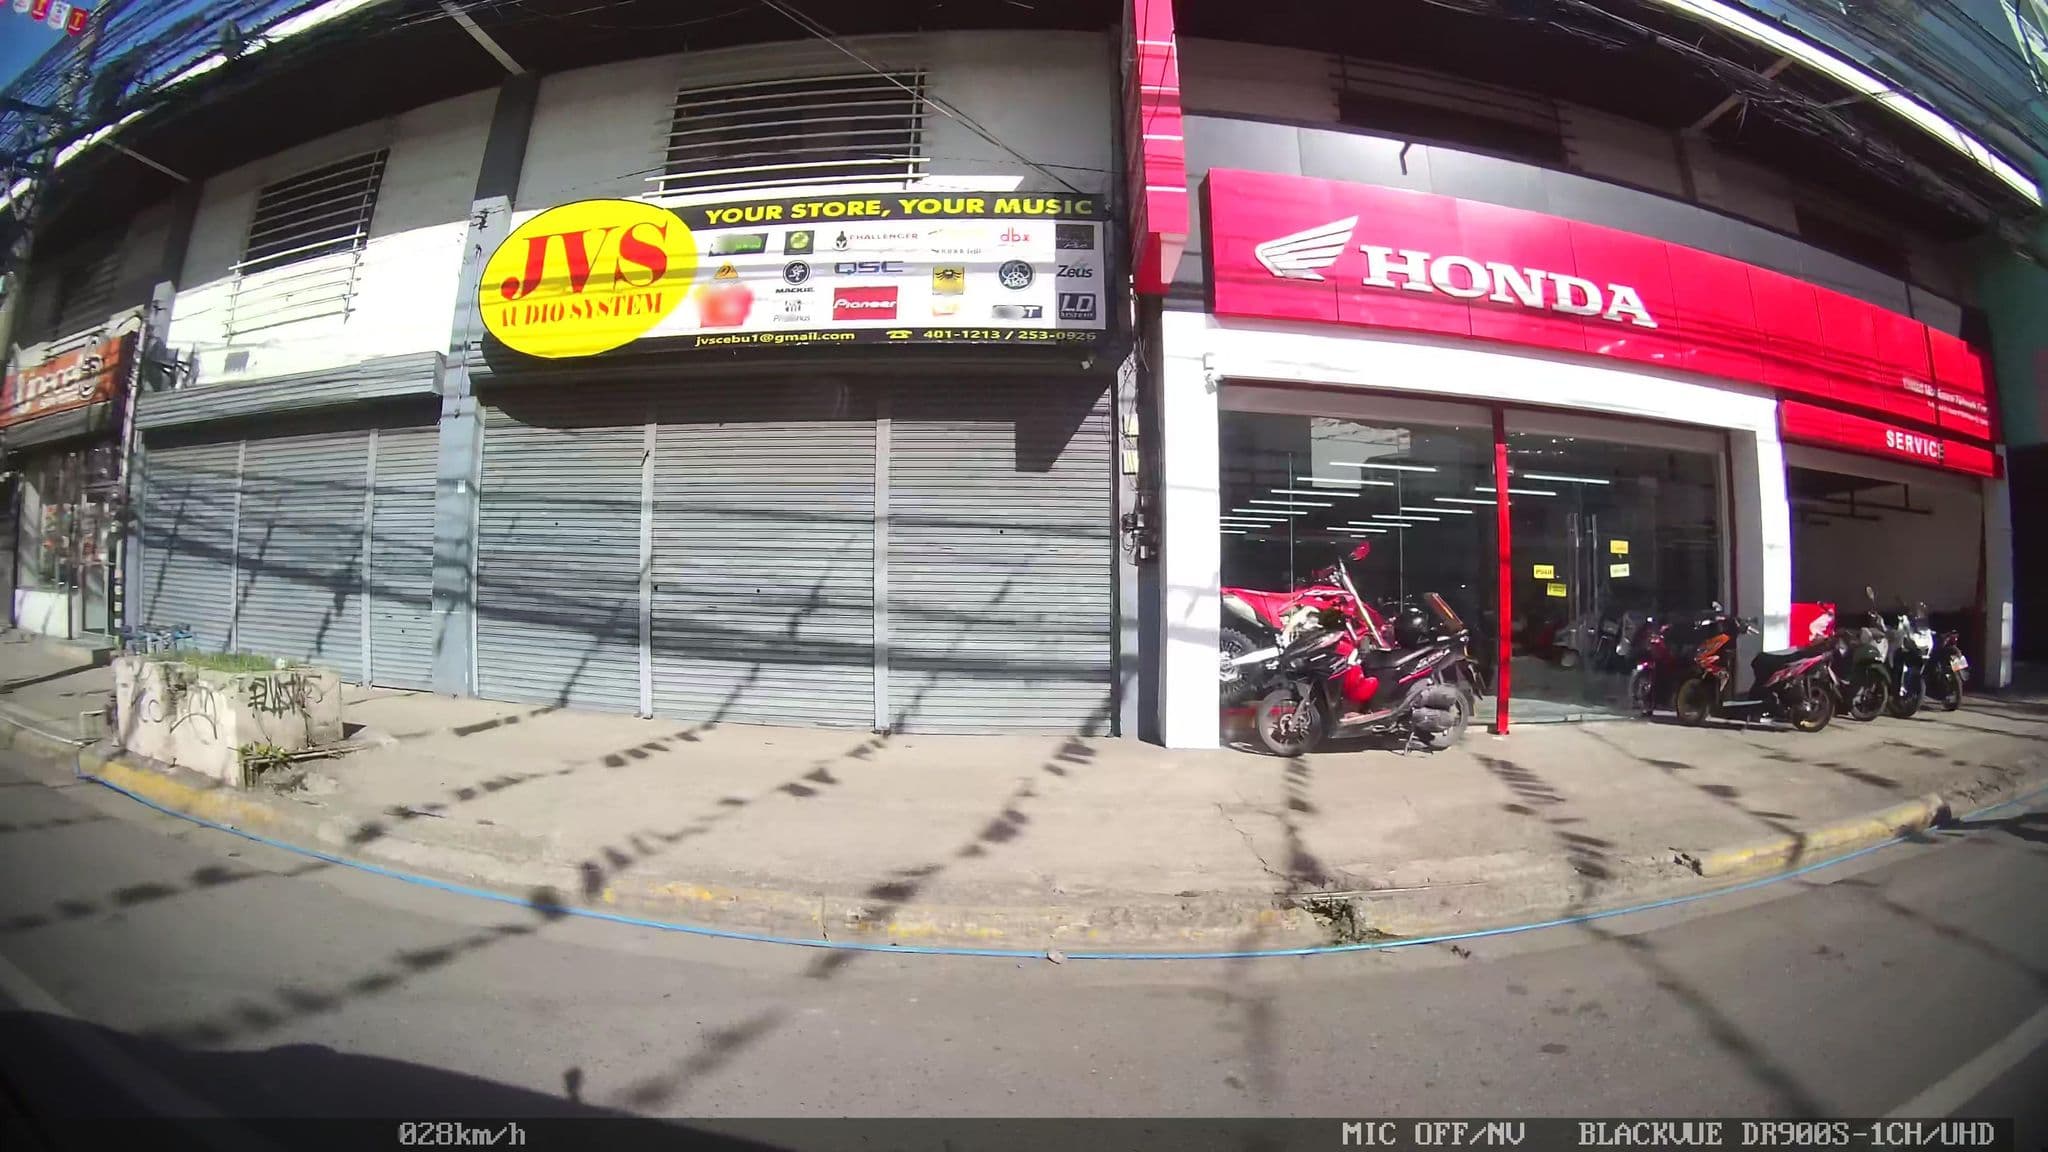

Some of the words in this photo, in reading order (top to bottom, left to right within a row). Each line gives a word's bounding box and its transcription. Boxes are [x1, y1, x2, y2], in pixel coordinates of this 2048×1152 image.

[705, 205, 782, 225] YOUR
[790, 200, 891, 218] STORE,
[898, 198, 985, 214] YOUR
[994, 198, 1093, 214] MUSIC
[1000, 228, 1031, 242] dbx
[501, 221, 668, 300] JVS
[834, 261, 904, 275] QSC
[1056, 264, 1093, 278] Zeus
[1360, 244, 1658, 328] HONDA
[501, 302, 564, 327] AUDIO
[571, 293, 662, 320] SYSTEM
[834, 299, 896, 309] Pioneer
[1061, 295, 1093, 312] LD
[695, 332, 855, 346] jvscebu1@gmail.com
[924, 330, 1000, 339] 401-1213
[1018, 331, 1096, 341] 253-0926
[1886, 429, 1944, 459] SERVICE
